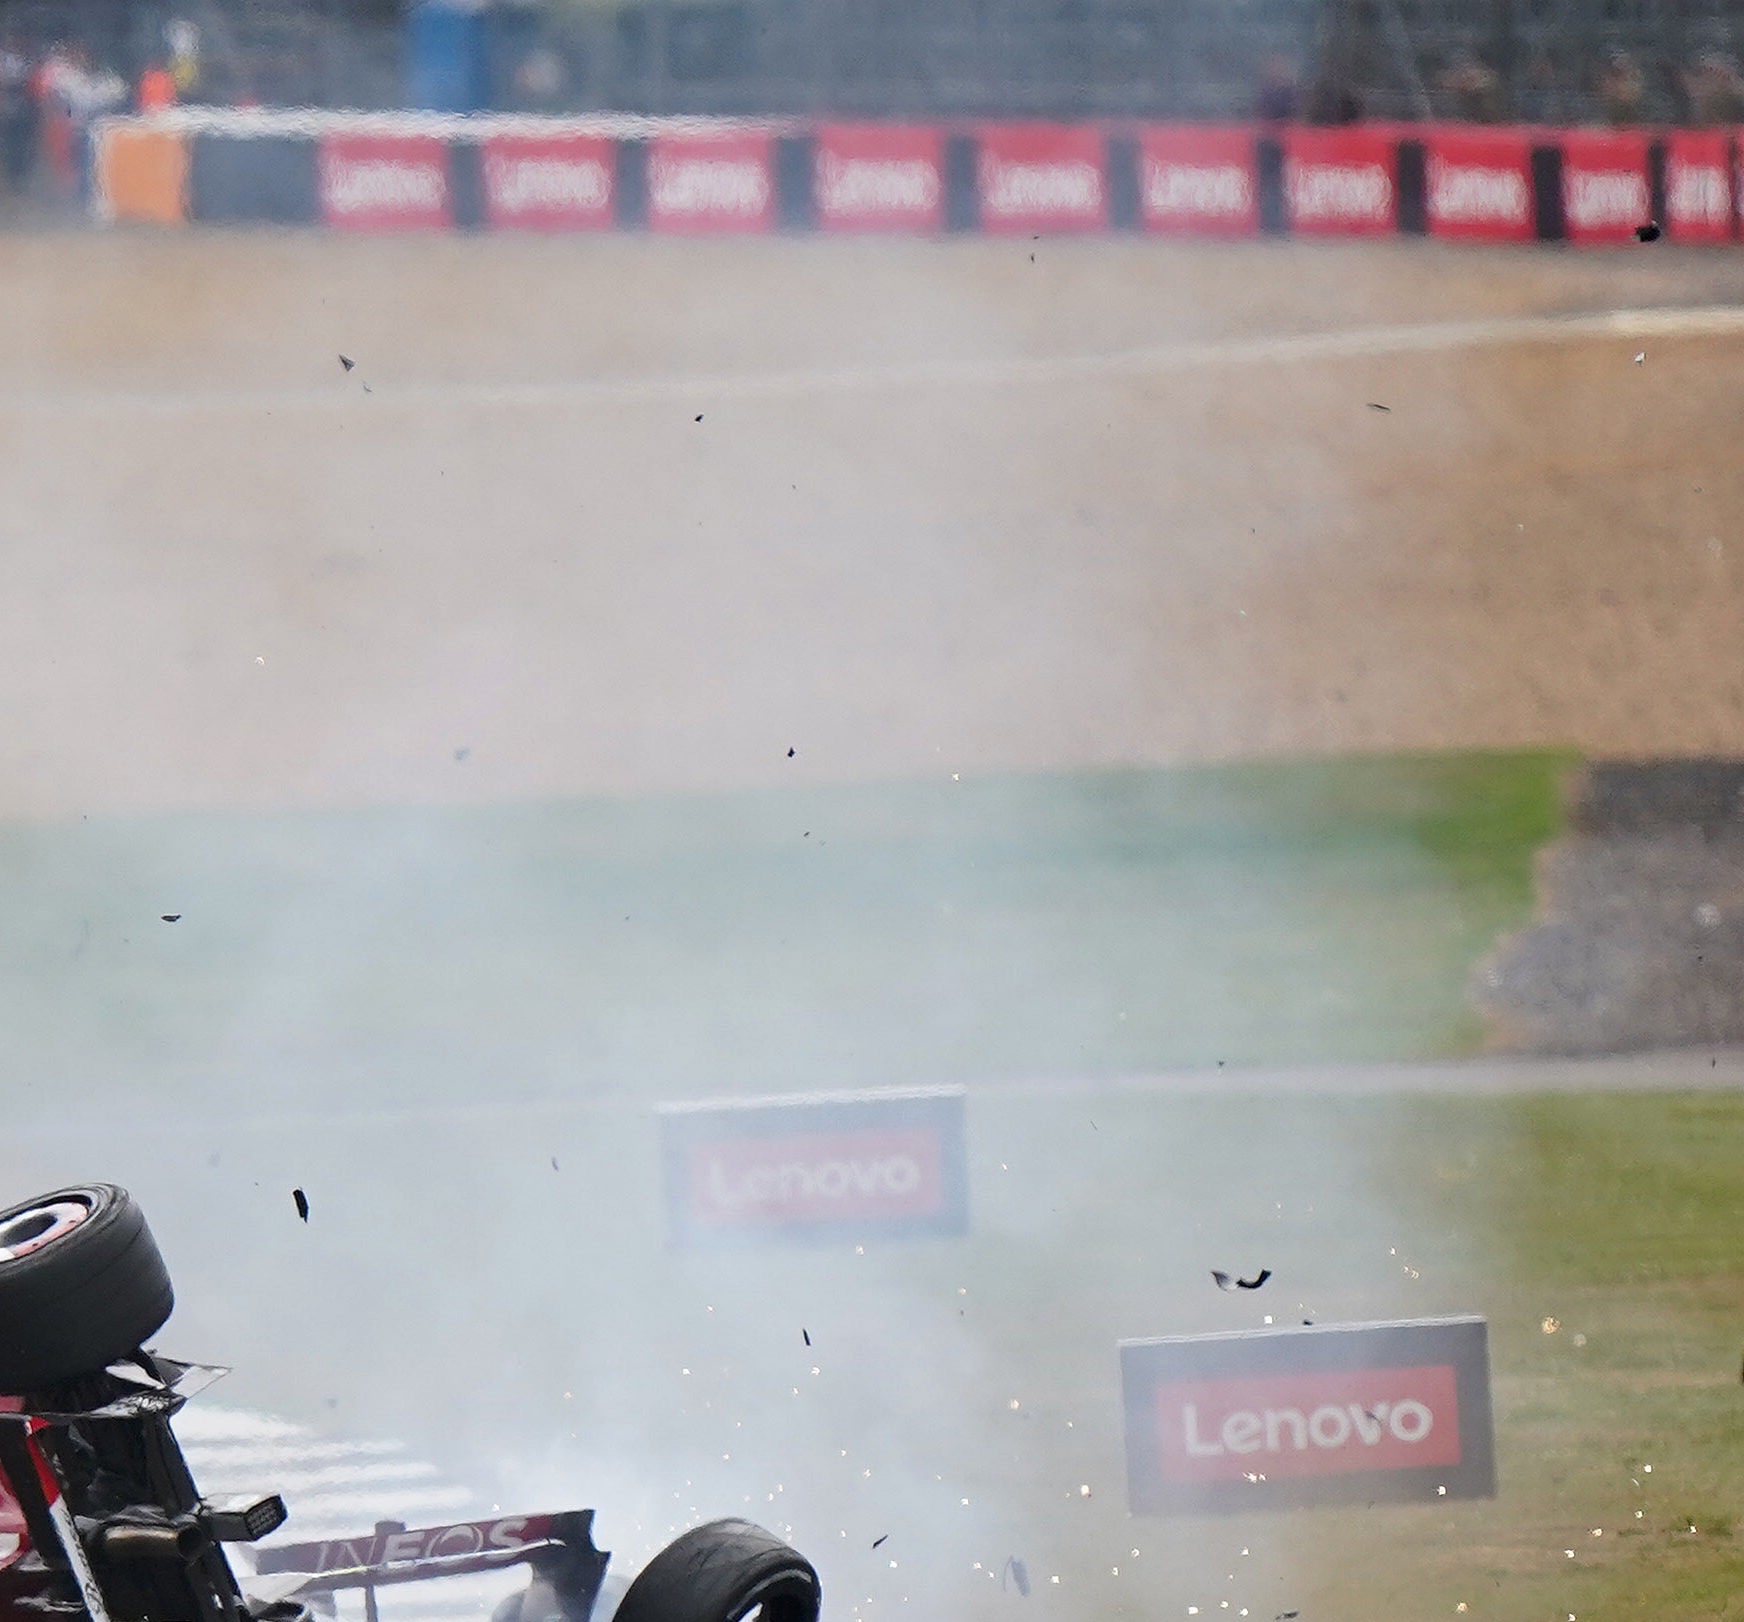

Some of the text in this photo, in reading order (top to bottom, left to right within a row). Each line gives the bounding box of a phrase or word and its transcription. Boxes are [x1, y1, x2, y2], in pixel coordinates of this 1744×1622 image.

[711, 1153, 921, 1205] Lenovo
[1183, 1396, 1433, 1457] Lenovo
[317, 1517, 528, 1569] INEOS
